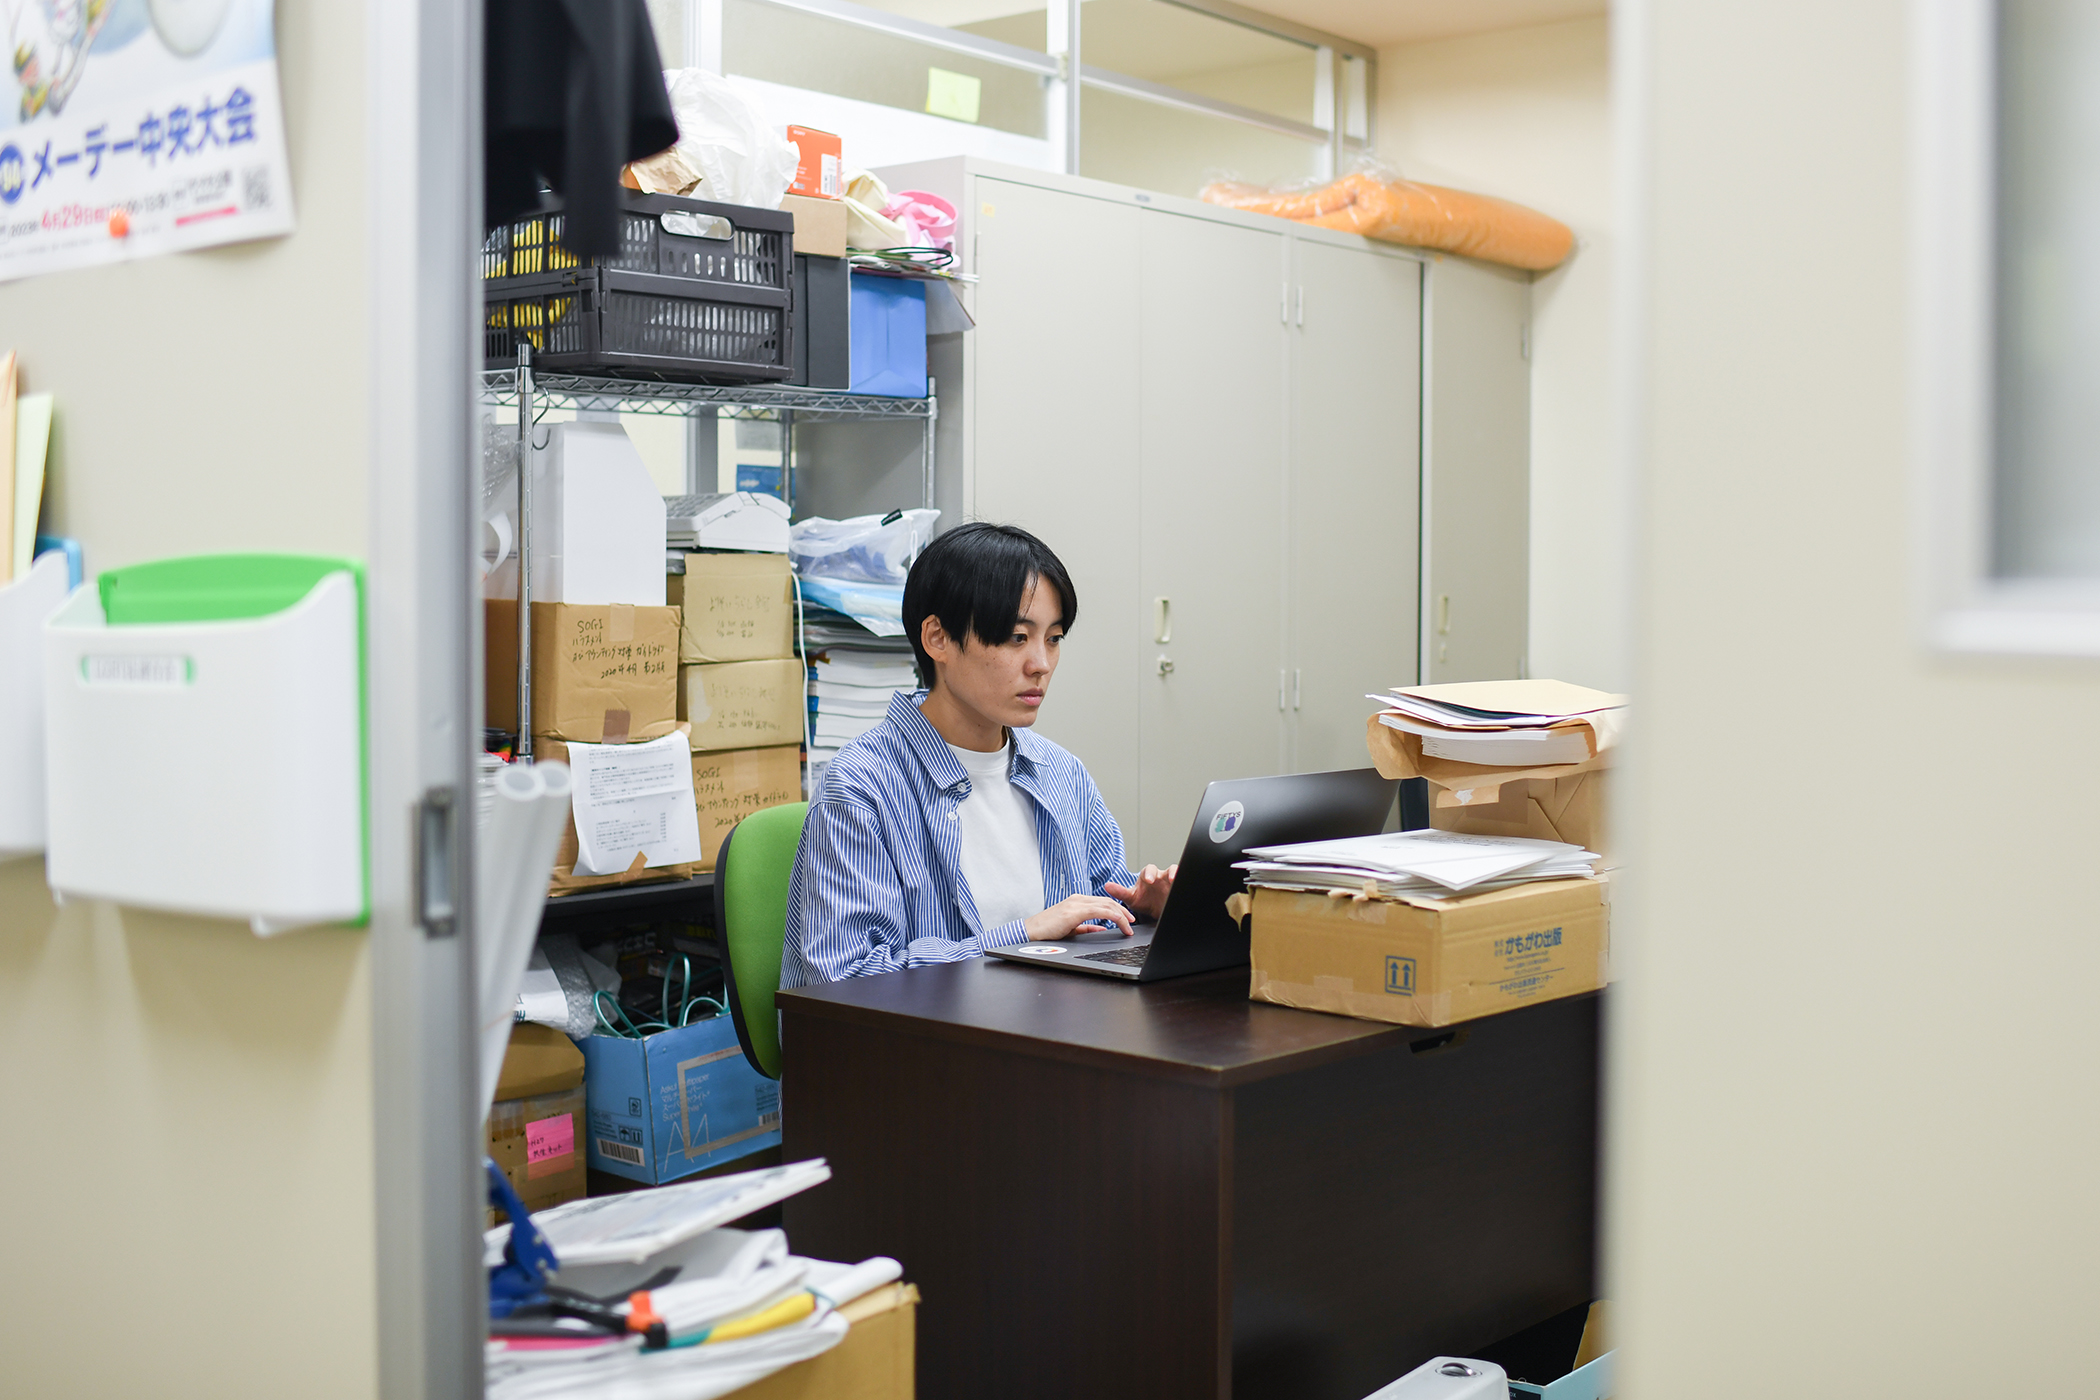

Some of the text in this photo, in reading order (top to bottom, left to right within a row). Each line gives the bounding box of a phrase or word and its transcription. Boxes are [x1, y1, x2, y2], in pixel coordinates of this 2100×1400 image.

[31, 87, 256, 189] メーデー中央大会
[577, 618, 603, 634] SOGI
[572, 632, 602, 646] ハラスメント
[696, 766, 720, 781] SOGI
[1216, 811, 1241, 820] FIFTYS
[1505, 927, 1562, 954] かもがわ出版
